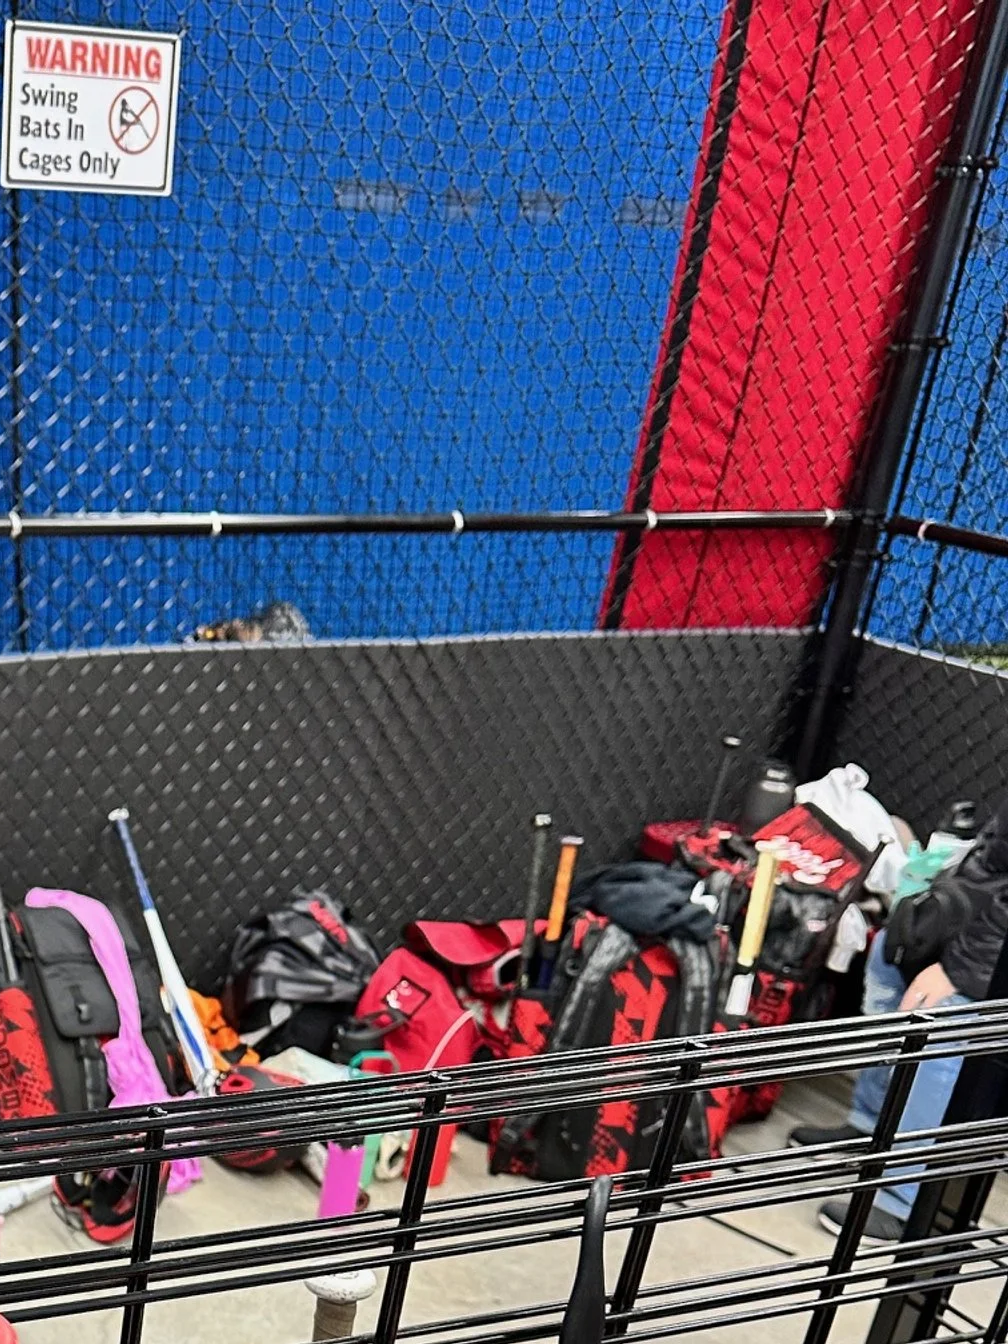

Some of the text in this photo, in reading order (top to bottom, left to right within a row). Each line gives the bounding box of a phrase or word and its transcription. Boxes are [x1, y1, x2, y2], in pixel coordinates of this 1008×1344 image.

[25, 36, 162, 79] WARNING
[20, 83, 79, 113] Swing
[19, 114, 85, 141] Bats In
[18, 147, 121, 178] Cages Only
